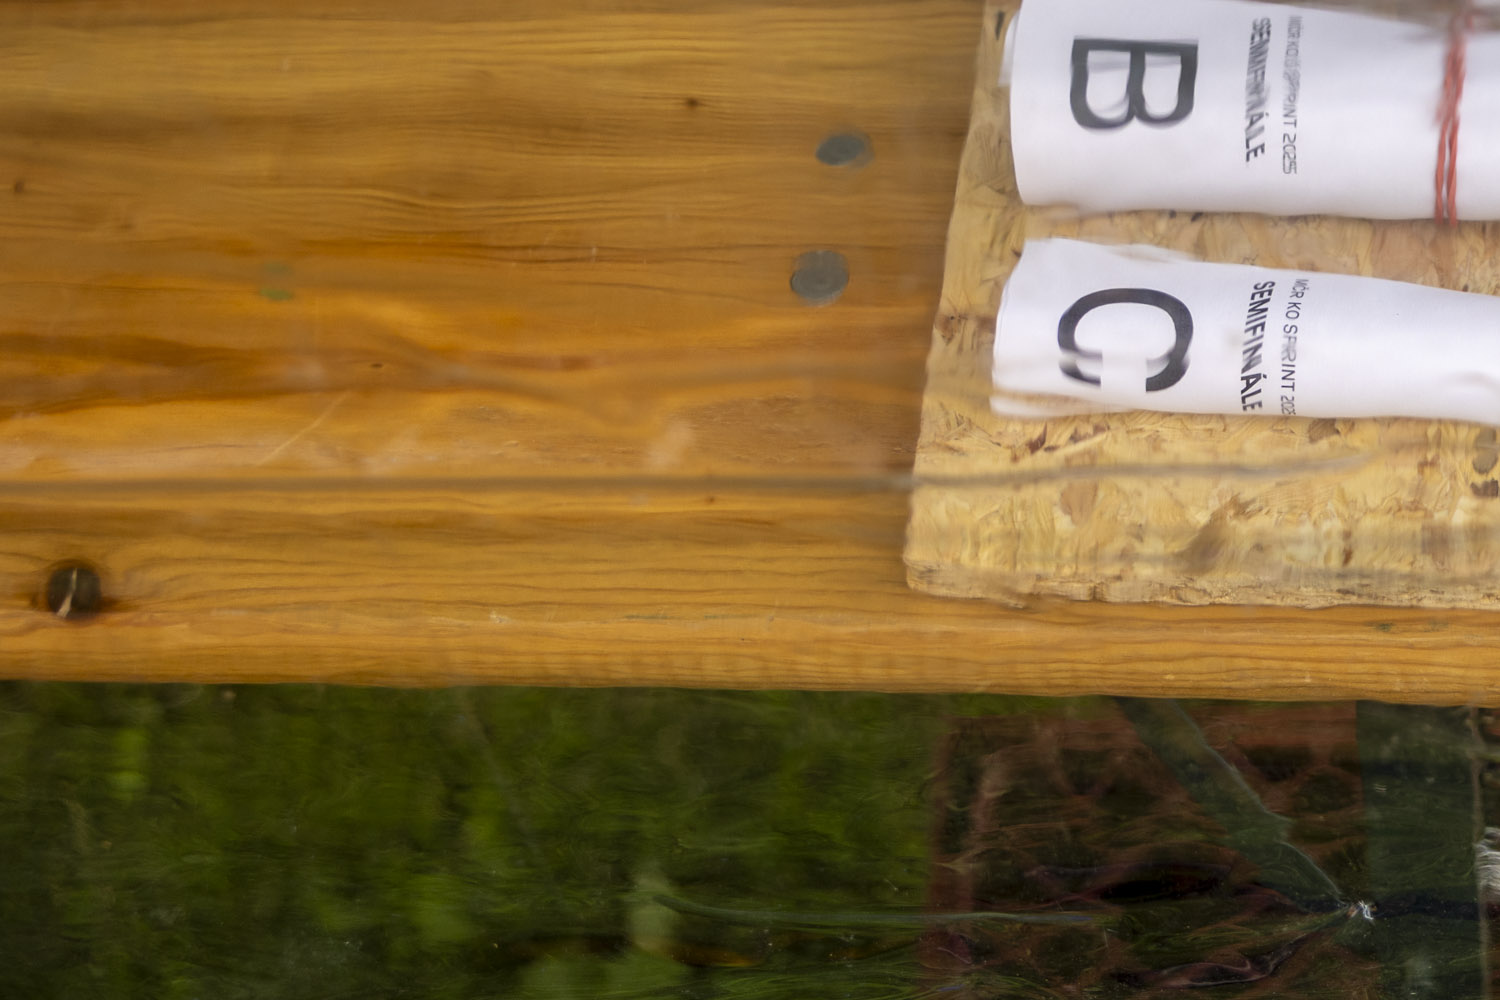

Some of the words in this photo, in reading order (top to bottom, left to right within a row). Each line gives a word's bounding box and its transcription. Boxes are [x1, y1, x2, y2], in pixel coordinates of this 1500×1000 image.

[1069, 36, 1199, 131] B
[1282, 133, 1298, 174] 2025
[1285, 302, 1302, 320] KO
[1289, 278, 1310, 299] MČR
[1057, 287, 1194, 392] C
[1240, 280, 1276, 412] SEMIFINÁLE
[1281, 324, 1298, 391] SPRINT
